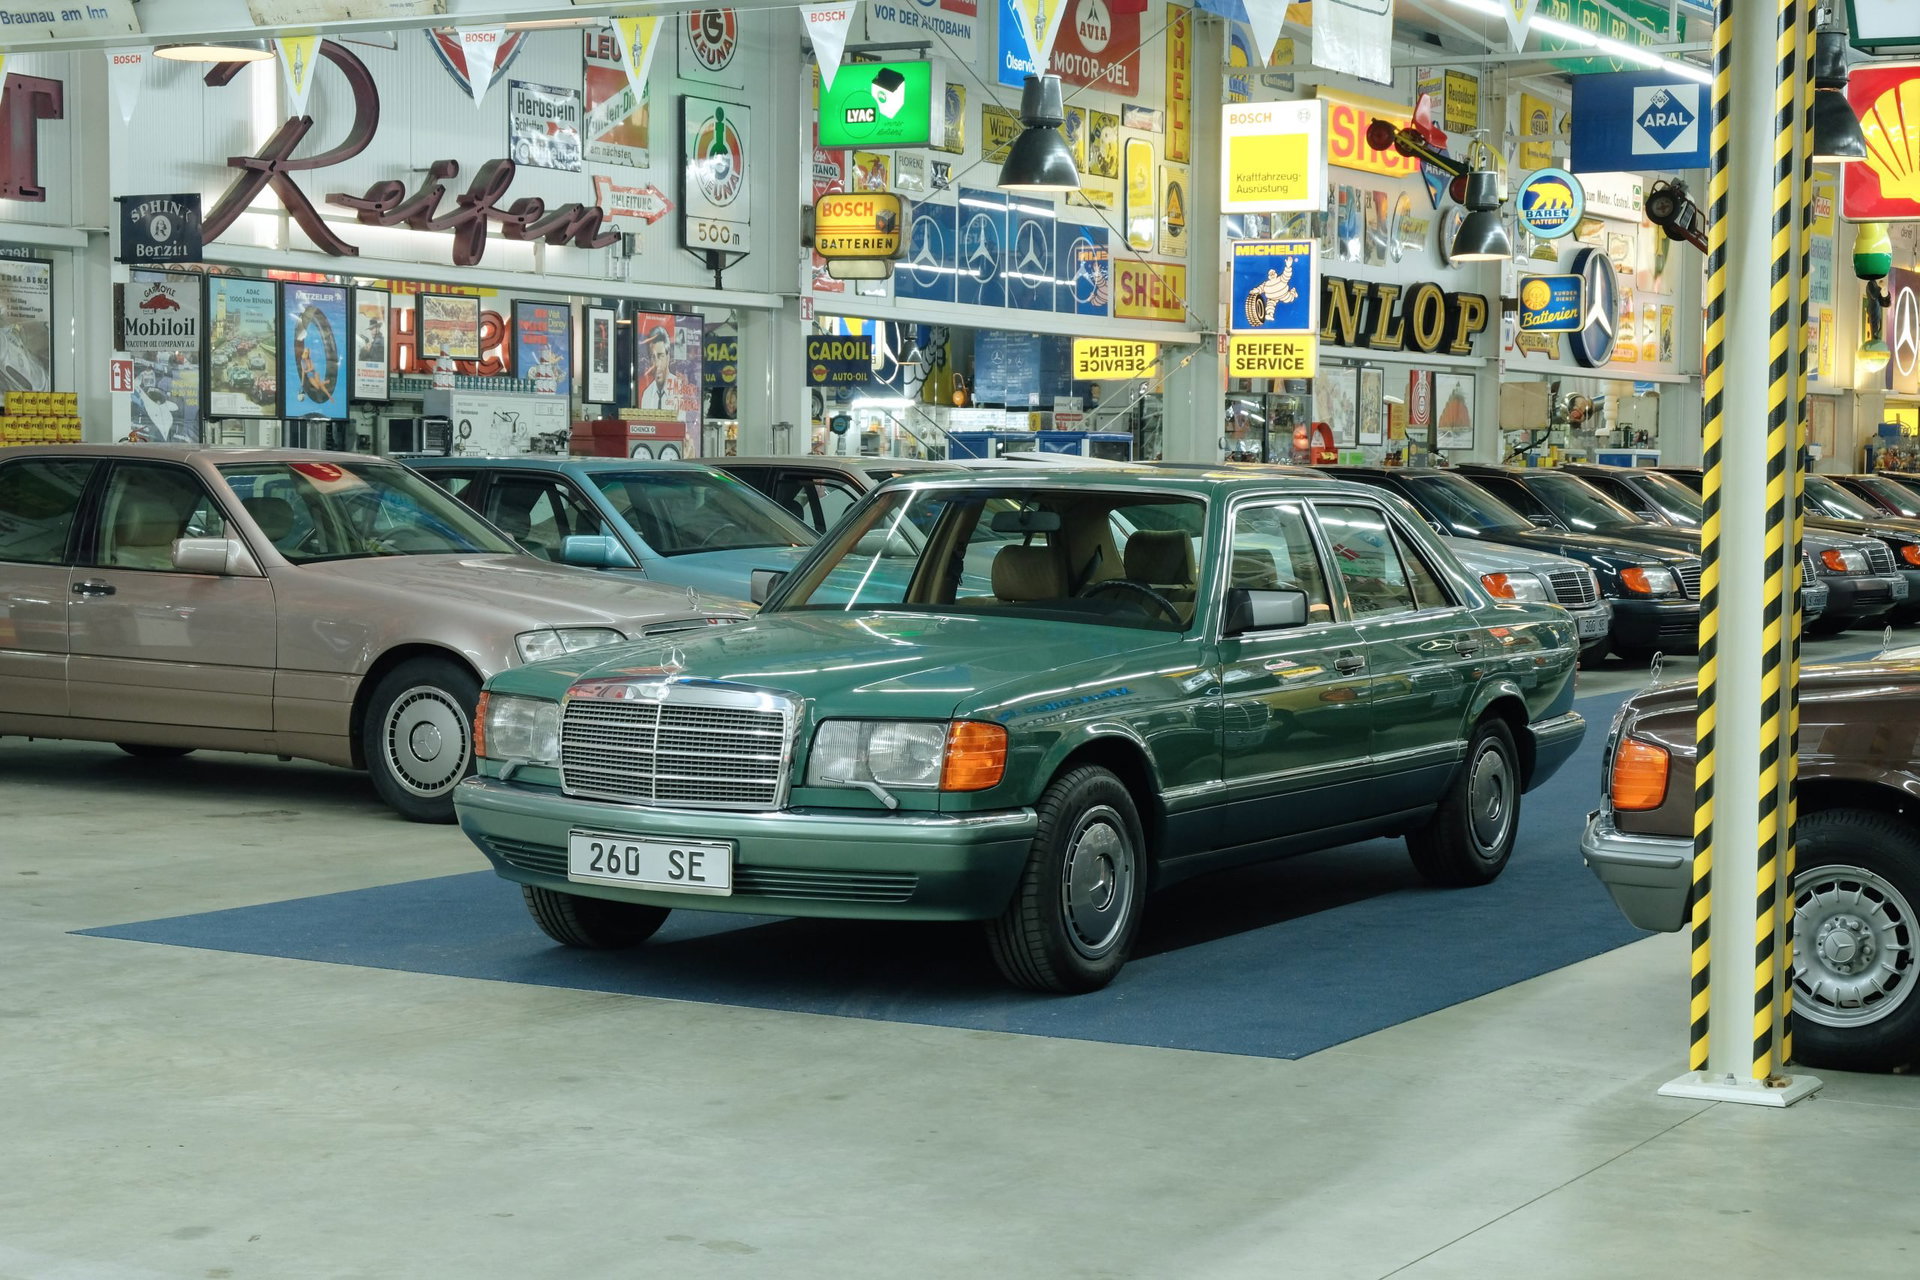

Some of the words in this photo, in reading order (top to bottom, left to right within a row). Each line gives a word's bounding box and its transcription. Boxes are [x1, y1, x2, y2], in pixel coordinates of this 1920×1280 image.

[0, 9, 55, 25] Braunau
[61, 8, 82, 21] am
[86, 5, 109, 19] Inn
[811, 11, 846, 23] BOSCH
[874, 4, 896, 22] VOR
[899, 10, 919, 27] DER
[921, 15, 972, 40] AUTOBAHN
[465, 33, 496, 43] BOSCH
[1079, 21, 1108, 41] AVIA
[585, 31, 622, 63] LEU
[692, 31, 733, 66] LEUNA
[114, 54, 142, 65] BOSCH
[1006, 50, 1037, 74] Ölservic
[1172, 9, 1186, 160] SHELL
[517, 91, 575, 122] Herbstein
[846, 108, 875, 123] LYAC
[1230, 112, 1272, 125] BOSCH
[1643, 112, 1688, 128] ARAL
[989, 117, 1020, 141] Würzb
[1331, 106, 1421, 171] Shl
[200, 38, 622, 266] Reifen
[602, 145, 632, 160] nächsten
[813, 163, 838, 177] TANOL
[1236, 172, 1302, 182] Kraftfahrzeug-
[611, 193, 653, 211] UMLEITUNG
[822, 201, 874, 217] BOSCH
[698, 222, 731, 244] 500
[732, 233, 740, 246] m
[136, 240, 188, 258] Benzin
[821, 238, 893, 250] BATTERIEN
[1235, 243, 1309, 256] MICHELIN
[1, 274, 49, 285] EDES-BENZ
[246, 288, 260, 296] ADAC
[1120, 270, 1181, 310] SHELL
[229, 296, 243, 304] 1000
[252, 297, 273, 305] RENNEN
[1320, 277, 1488, 356] NLOP
[1521, 306, 1578, 328] Batterien
[125, 317, 196, 337] Mobiloil
[125, 340, 149, 348] VACUUM
[158, 340, 185, 348] COMPANY
[808, 341, 870, 361] CAROIL
[1236, 343, 1304, 356] REIFEN-
[1236, 357, 1305, 371] SERVICE
[832, 371, 868, 382] AUTO-OIL
[589, 842, 641, 876] 260
[667, 849, 706, 882] SE
